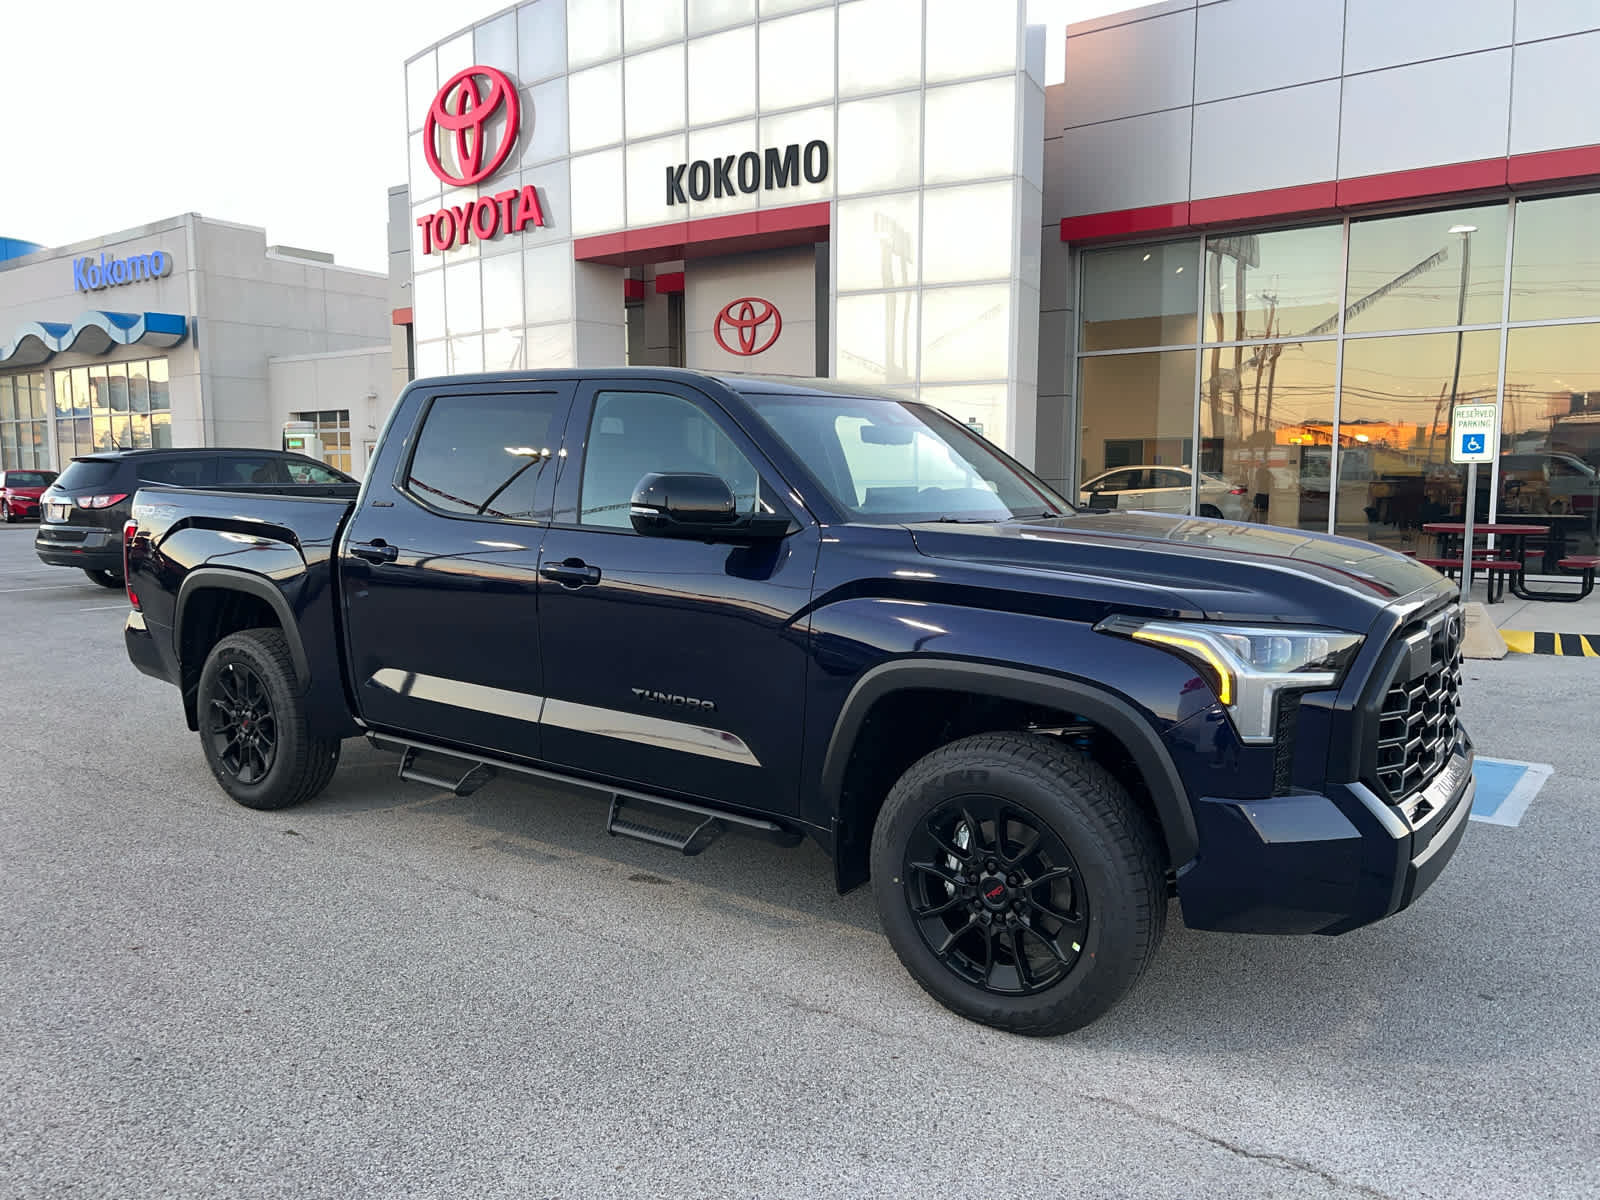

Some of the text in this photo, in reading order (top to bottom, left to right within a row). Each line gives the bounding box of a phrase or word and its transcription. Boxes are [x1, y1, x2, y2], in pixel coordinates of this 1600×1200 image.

[666, 139, 829, 206] KOKOMO
[416, 185, 545, 255] TOYOTA
[73, 250, 166, 293] Kokomo
[1456, 409, 1494, 419] RESERVED
[1458, 419, 1491, 428] PARKING
[631, 687, 717, 712] TUNDRA
